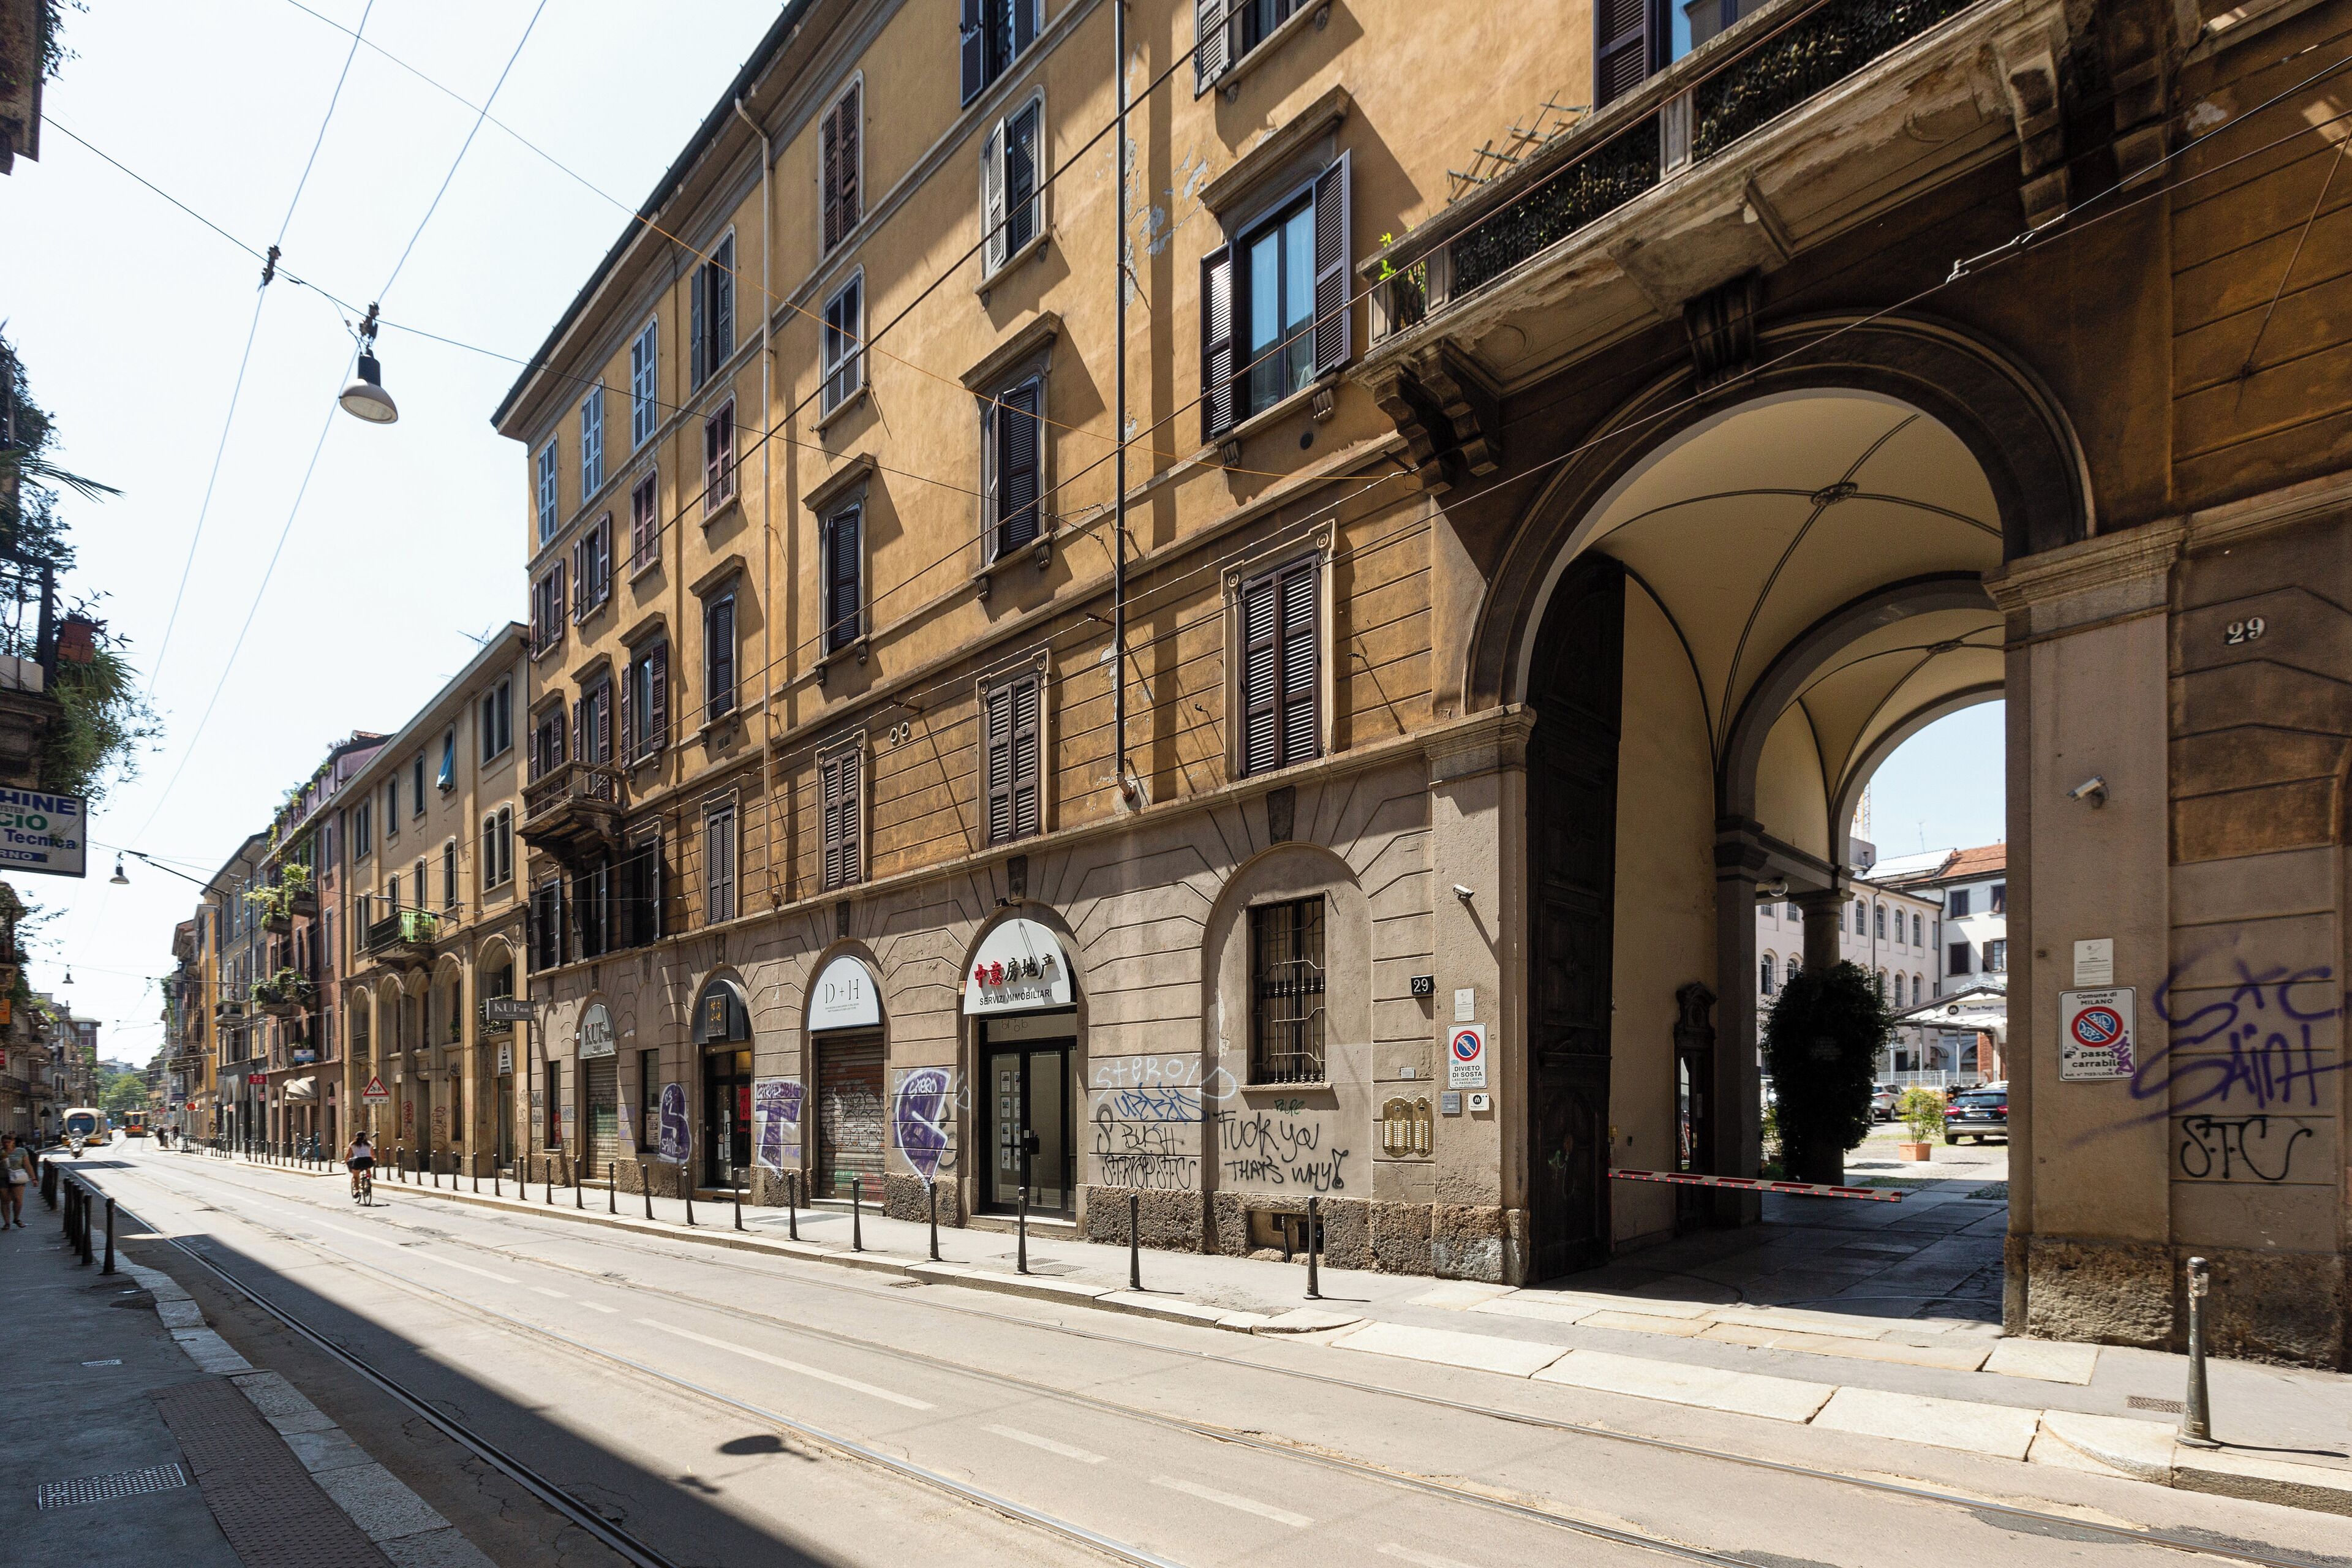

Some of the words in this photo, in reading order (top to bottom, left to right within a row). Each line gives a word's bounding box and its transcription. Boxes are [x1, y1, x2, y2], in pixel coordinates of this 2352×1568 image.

[2228, 617, 2265, 645] 29
[974, 953, 1054, 988] 中意房地产
[1414, 978, 1428, 993] 29
[979, 995, 1005, 1006] SERVIZI
[1008, 989, 1052, 1002] IMMOBILIARI
[494, 1003, 521, 1012] KUF
